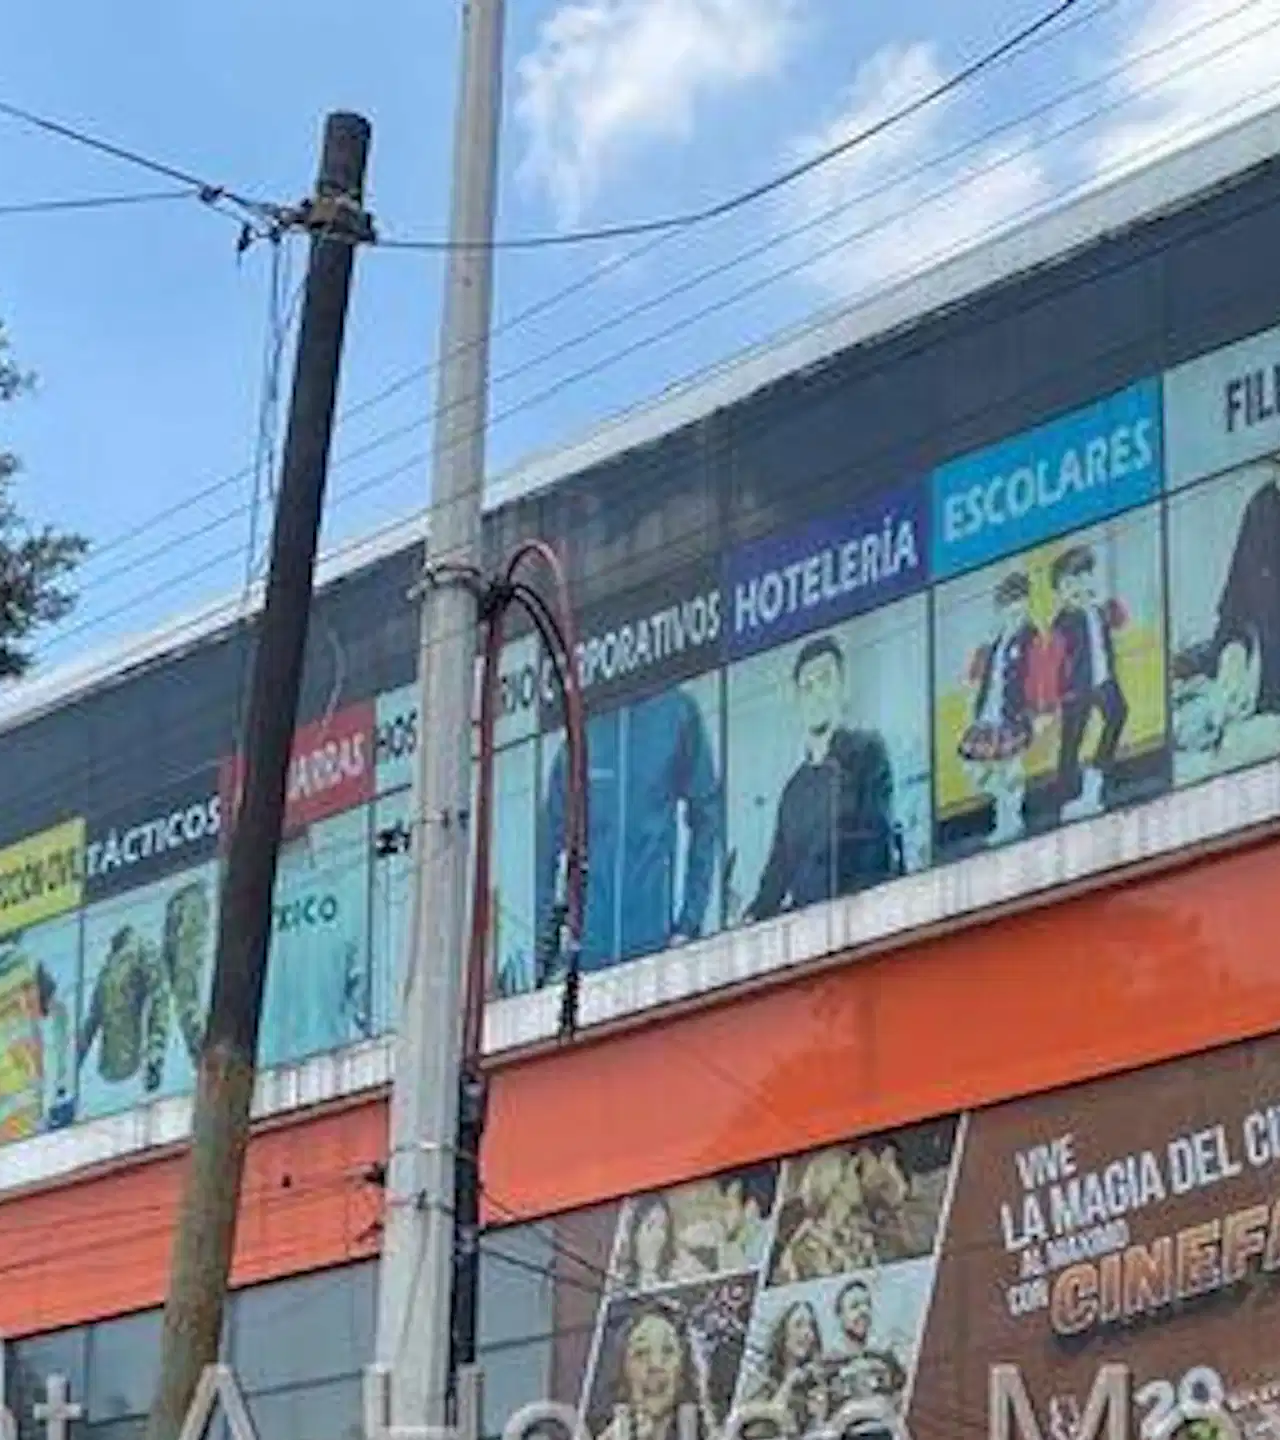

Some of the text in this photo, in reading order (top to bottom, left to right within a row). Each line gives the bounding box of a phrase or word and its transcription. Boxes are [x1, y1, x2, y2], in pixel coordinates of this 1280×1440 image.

[942, 418, 1156, 542] ESCOLARES
[734, 512, 918, 634] HOTELERÍA
[87, 794, 221, 877] TÁCTICOS
[1000, 1194, 1049, 1251] LA
[1047, 1150, 1162, 1237] MAGIA
[1167, 1124, 1242, 1196] DEL
[1015, 1133, 1077, 1192] VIVE
